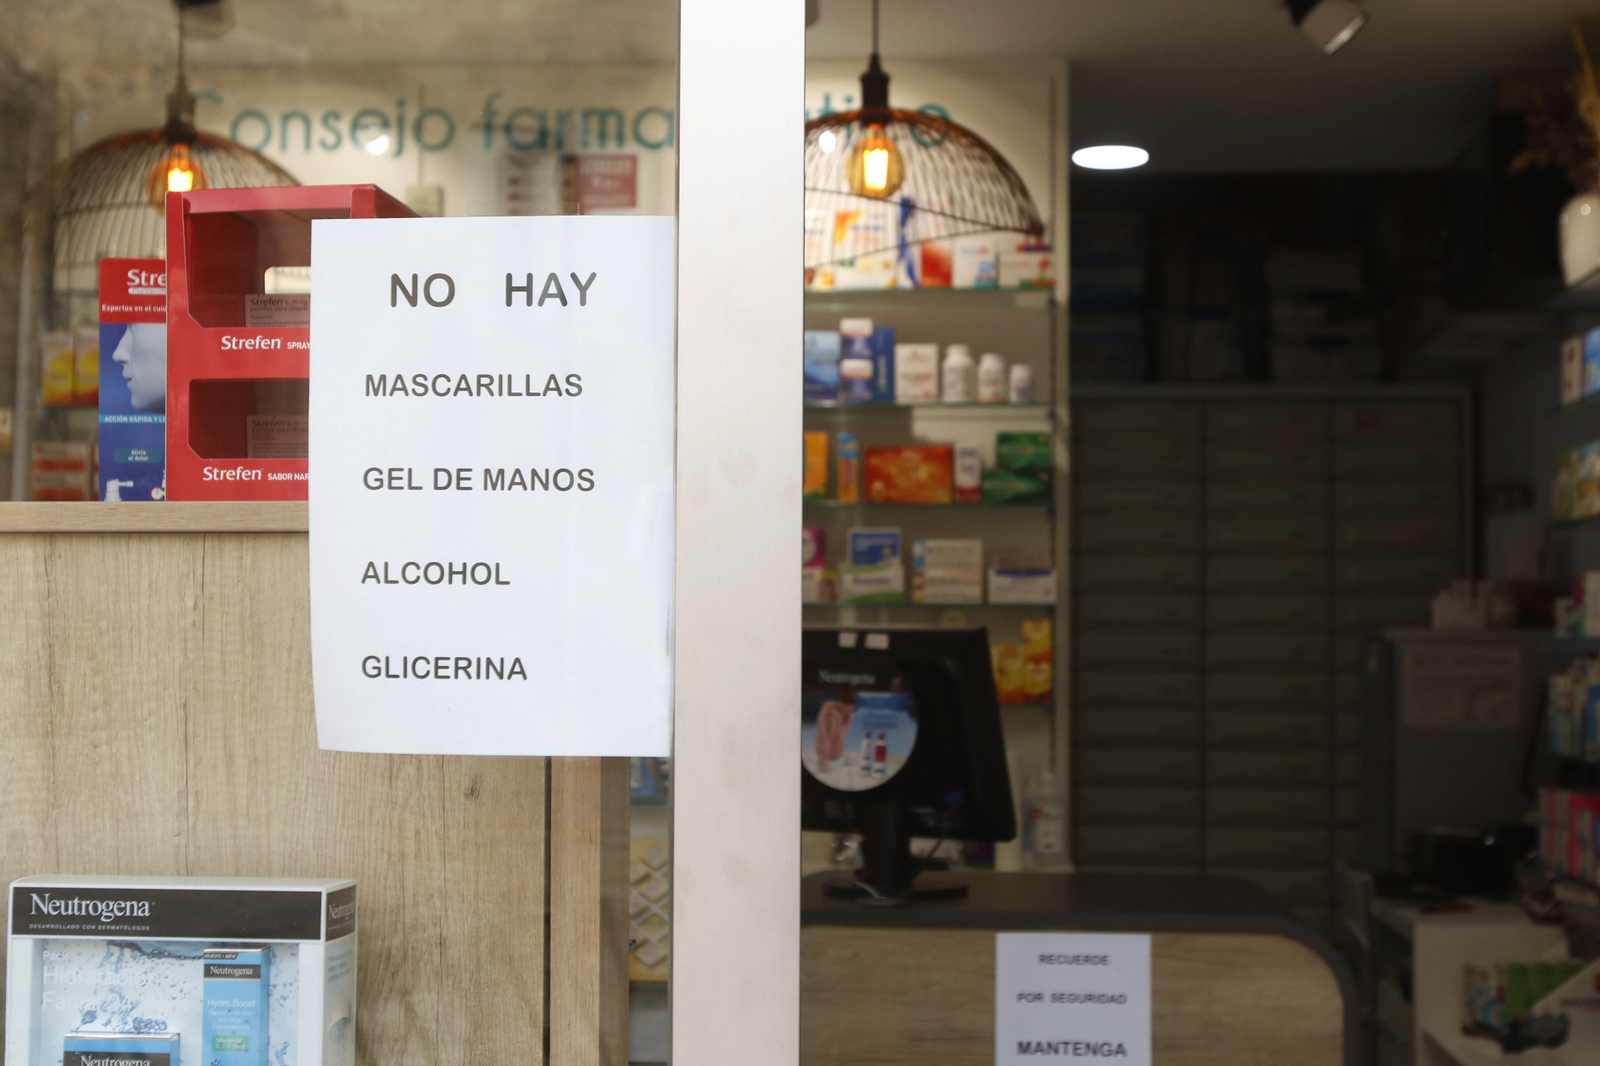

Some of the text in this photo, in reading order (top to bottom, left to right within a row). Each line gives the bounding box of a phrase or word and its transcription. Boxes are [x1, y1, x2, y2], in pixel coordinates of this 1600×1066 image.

[390, 272, 597, 307] NO HAY
[102, 303, 133, 313] Expertos
[144, 304, 151, 312] el
[220, 335, 311, 350] Strefen SPRAY
[365, 373, 583, 397] MASCARILLAS
[104, 414, 126, 423] ACCIÓN
[129, 414, 152, 423] RÁPIDA
[202, 466, 262, 481] Strefen
[267, 472, 293, 481] SABOR
[363, 467, 595, 492] GEL DE MANOS
[361, 561, 511, 585] ALCOHOL
[361, 655, 528, 681] GLICERINA
[29, 893, 151, 922] Neutrogena
[42, 950, 68, 961] Pack
[1038, 955, 1110, 966] RECUERDE
[209, 965, 253, 977] Neutrogena
[207, 999, 257, 1009] Hydro Boost
[1016, 993, 1128, 1004] POR SEGURIDAD
[1016, 1041, 1128, 1058] MANTENGA
